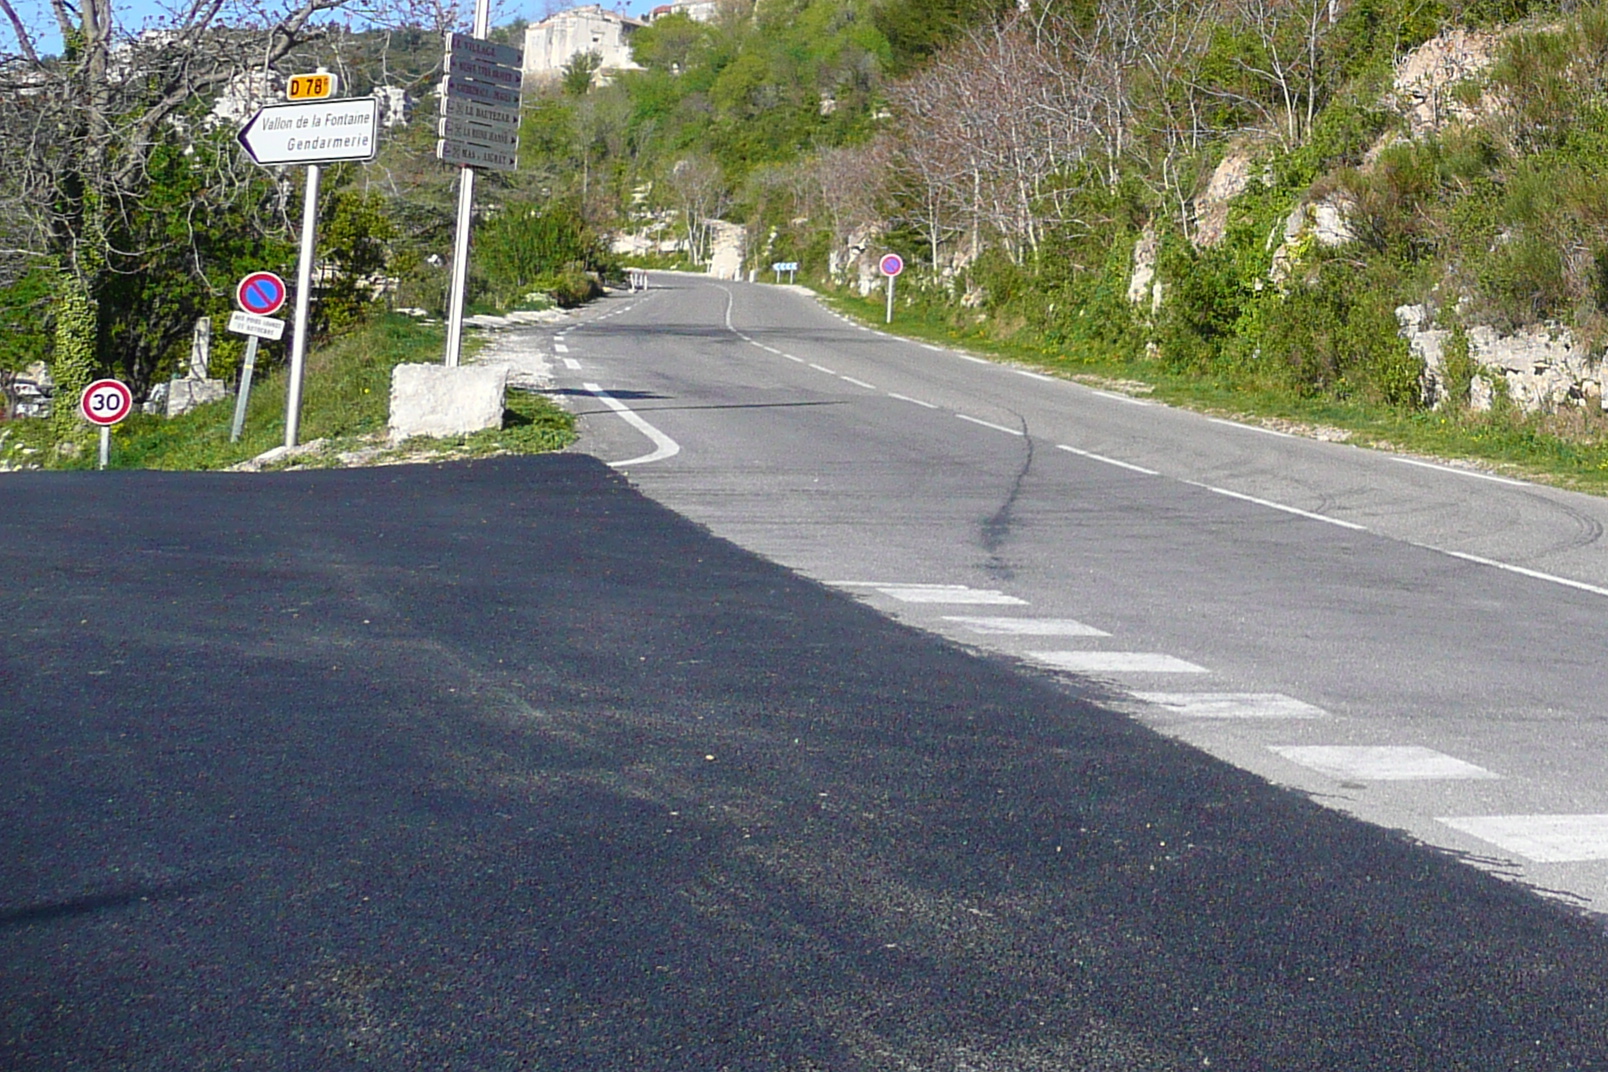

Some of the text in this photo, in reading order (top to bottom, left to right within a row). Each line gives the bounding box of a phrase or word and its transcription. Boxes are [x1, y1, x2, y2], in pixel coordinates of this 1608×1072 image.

[291, 79, 299, 96] D
[262, 112, 370, 131] Vallon de la Fontaine
[287, 132, 369, 151] Gendarmerie
[92, 393, 120, 411] 30
